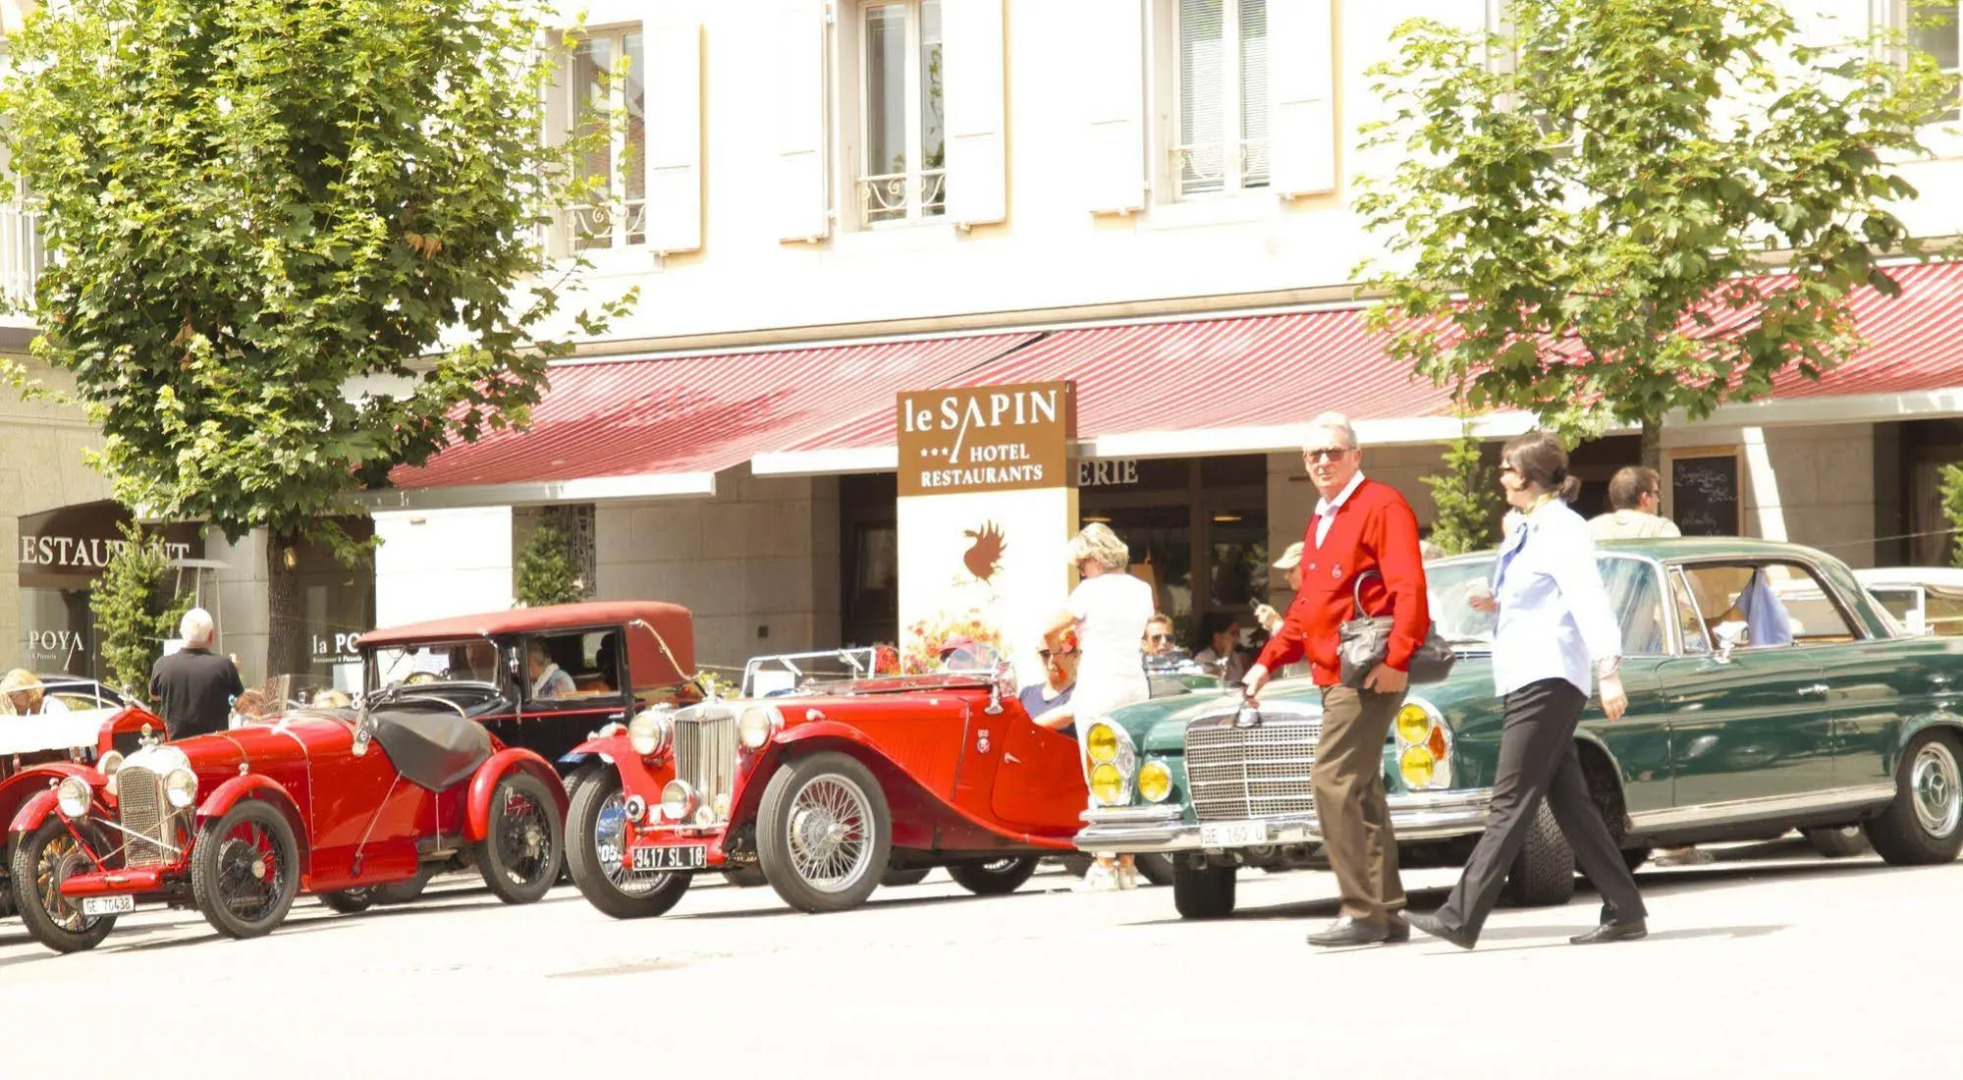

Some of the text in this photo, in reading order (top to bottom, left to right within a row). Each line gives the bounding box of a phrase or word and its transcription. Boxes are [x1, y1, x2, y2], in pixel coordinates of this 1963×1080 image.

[904, 389, 1057, 464] le SAPIN
[970, 443, 1030, 463] HOTEL
[920, 464, 1043, 487] RESTAURANTS
[29, 630, 84, 670] POYA
[312, 634, 327, 654] la
[635, 847, 664, 868] 9417
[668, 847, 684, 867] SL
